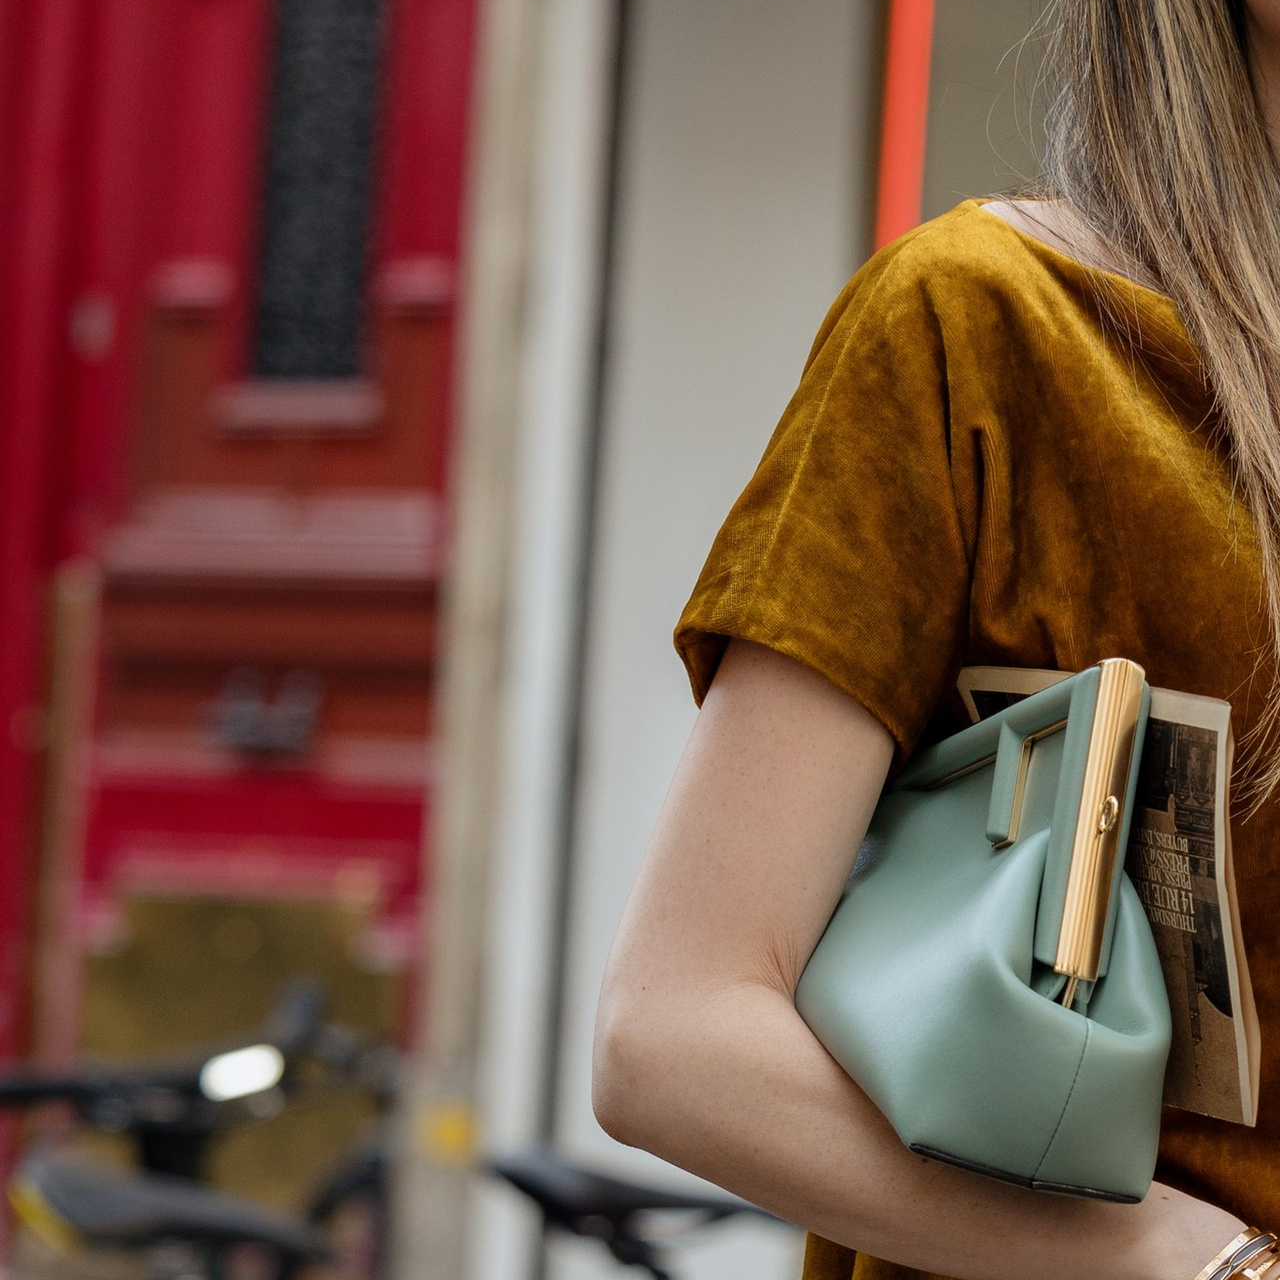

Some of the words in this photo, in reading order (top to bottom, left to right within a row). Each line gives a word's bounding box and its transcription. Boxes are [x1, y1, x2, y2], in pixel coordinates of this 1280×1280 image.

[1154, 828, 1189, 853] BUYERS,
[1152, 884, 1181, 912] RUE
[1181, 890, 1195, 915] 14
